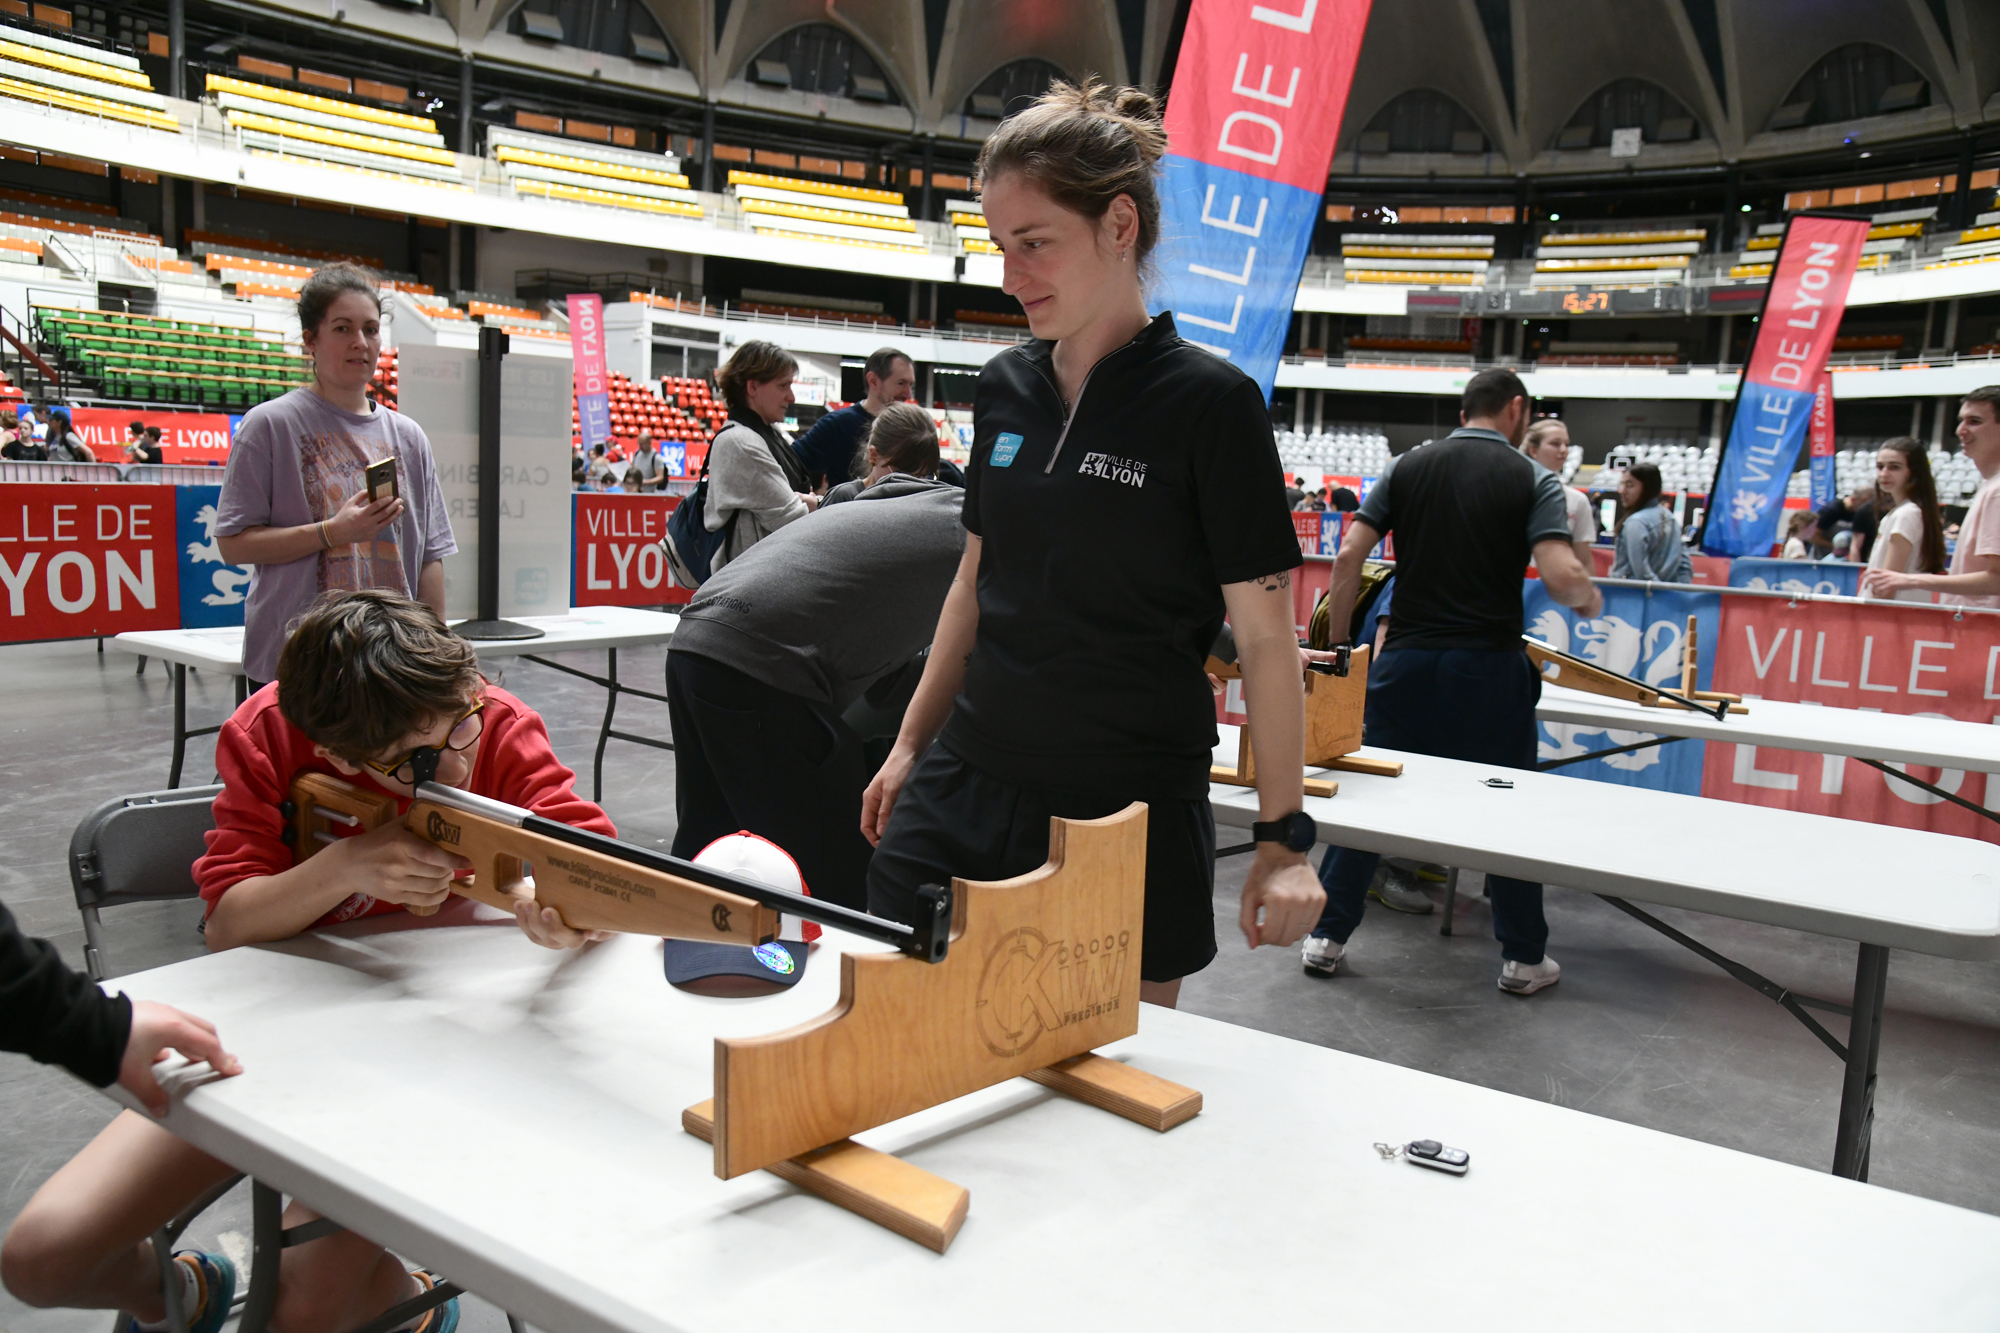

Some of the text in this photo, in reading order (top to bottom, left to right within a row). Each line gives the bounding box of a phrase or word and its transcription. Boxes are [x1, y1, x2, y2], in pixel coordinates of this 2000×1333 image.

[1217, 52, 1301, 166] DE
[1176, 183, 1269, 358] ILLE
[1562, 292, 1609, 311] 15:27
[1740, 241, 1840, 483] VILLE DE LYON
[177, 428, 228, 449] LYON
[998, 436, 1009, 444] en
[1101, 463, 1145, 488] LYON
[1106, 454, 1148, 473] VILLE DE
[96, 504, 153, 541] DE
[586, 508, 657, 537] VILLE
[1745, 625, 1955, 697] VILLE
[1063, 998, 1120, 1026] PRECISION
